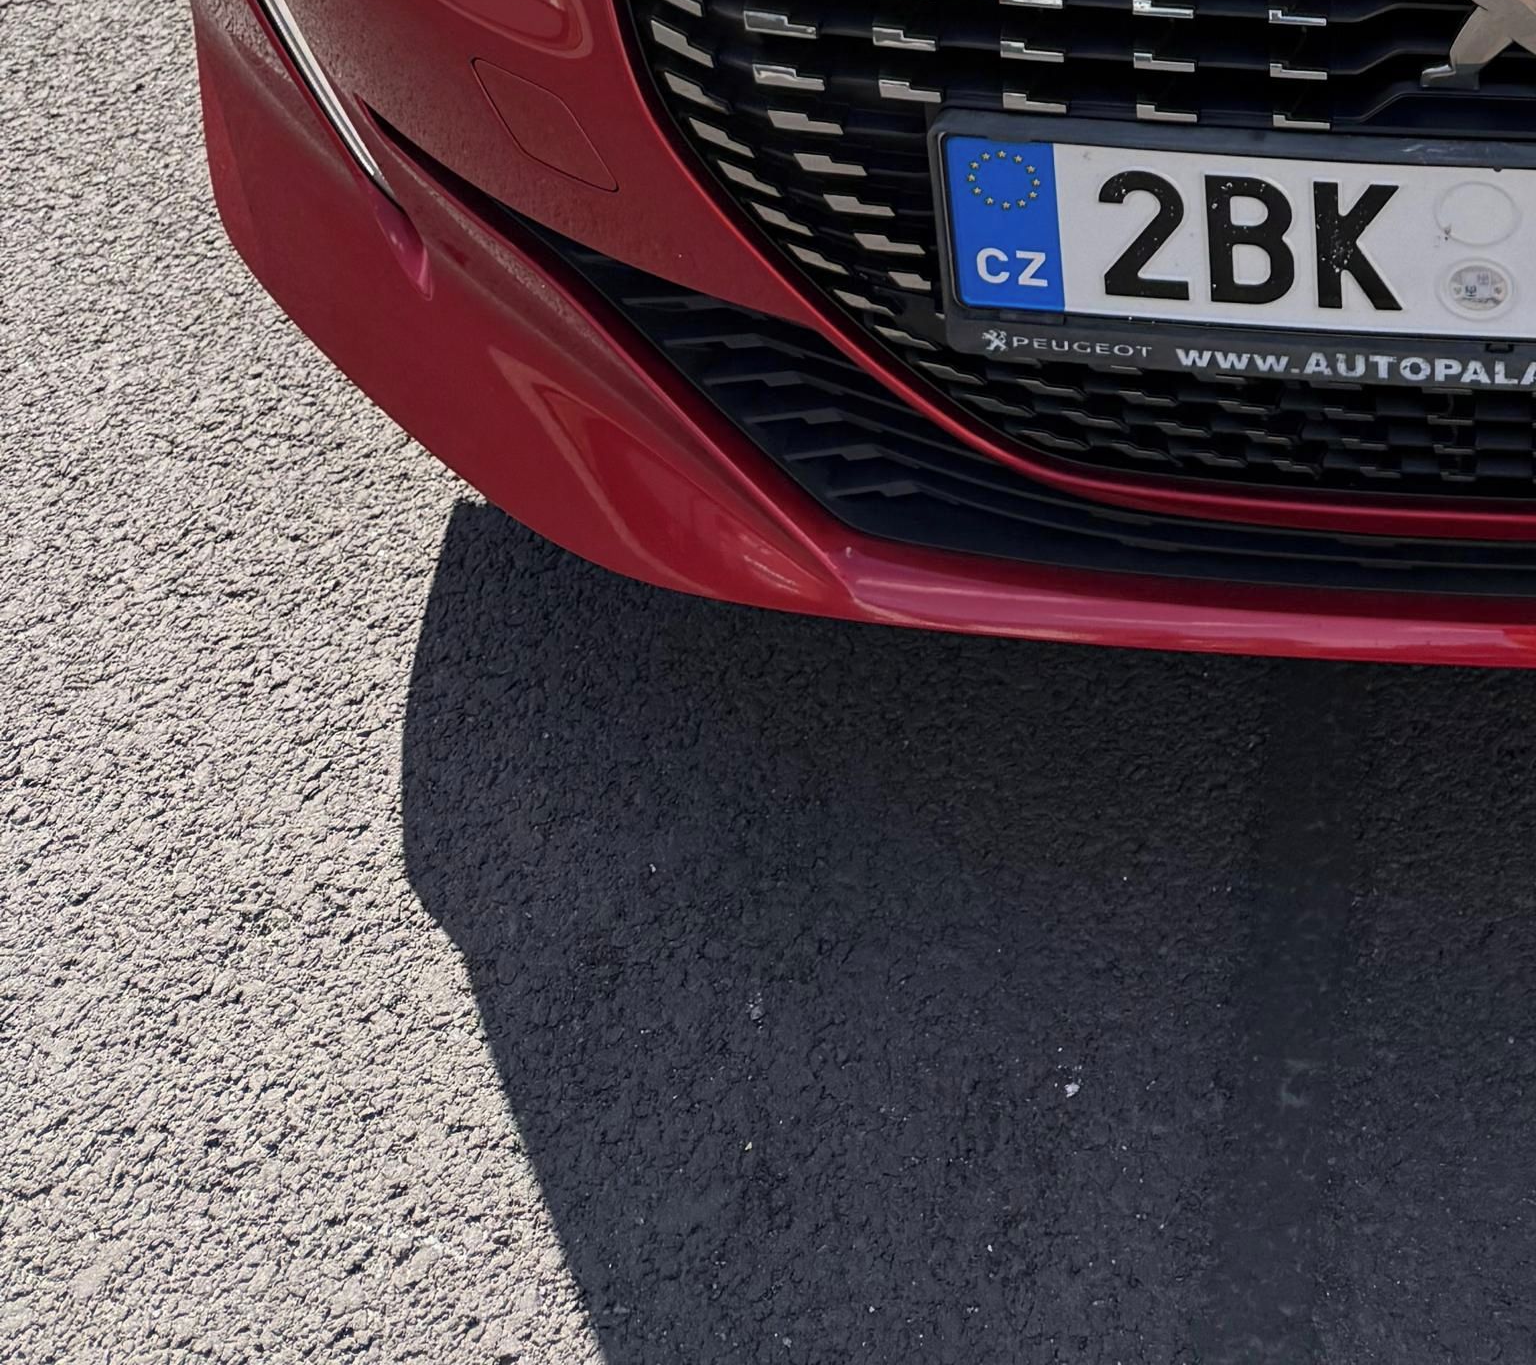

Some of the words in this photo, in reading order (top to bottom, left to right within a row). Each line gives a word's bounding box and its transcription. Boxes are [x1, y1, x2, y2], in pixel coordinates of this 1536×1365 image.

[1098, 169, 1403, 312] 2BK
[976, 247, 1049, 288] CZ
[1012, 336, 1152, 358] PEUGEOT
